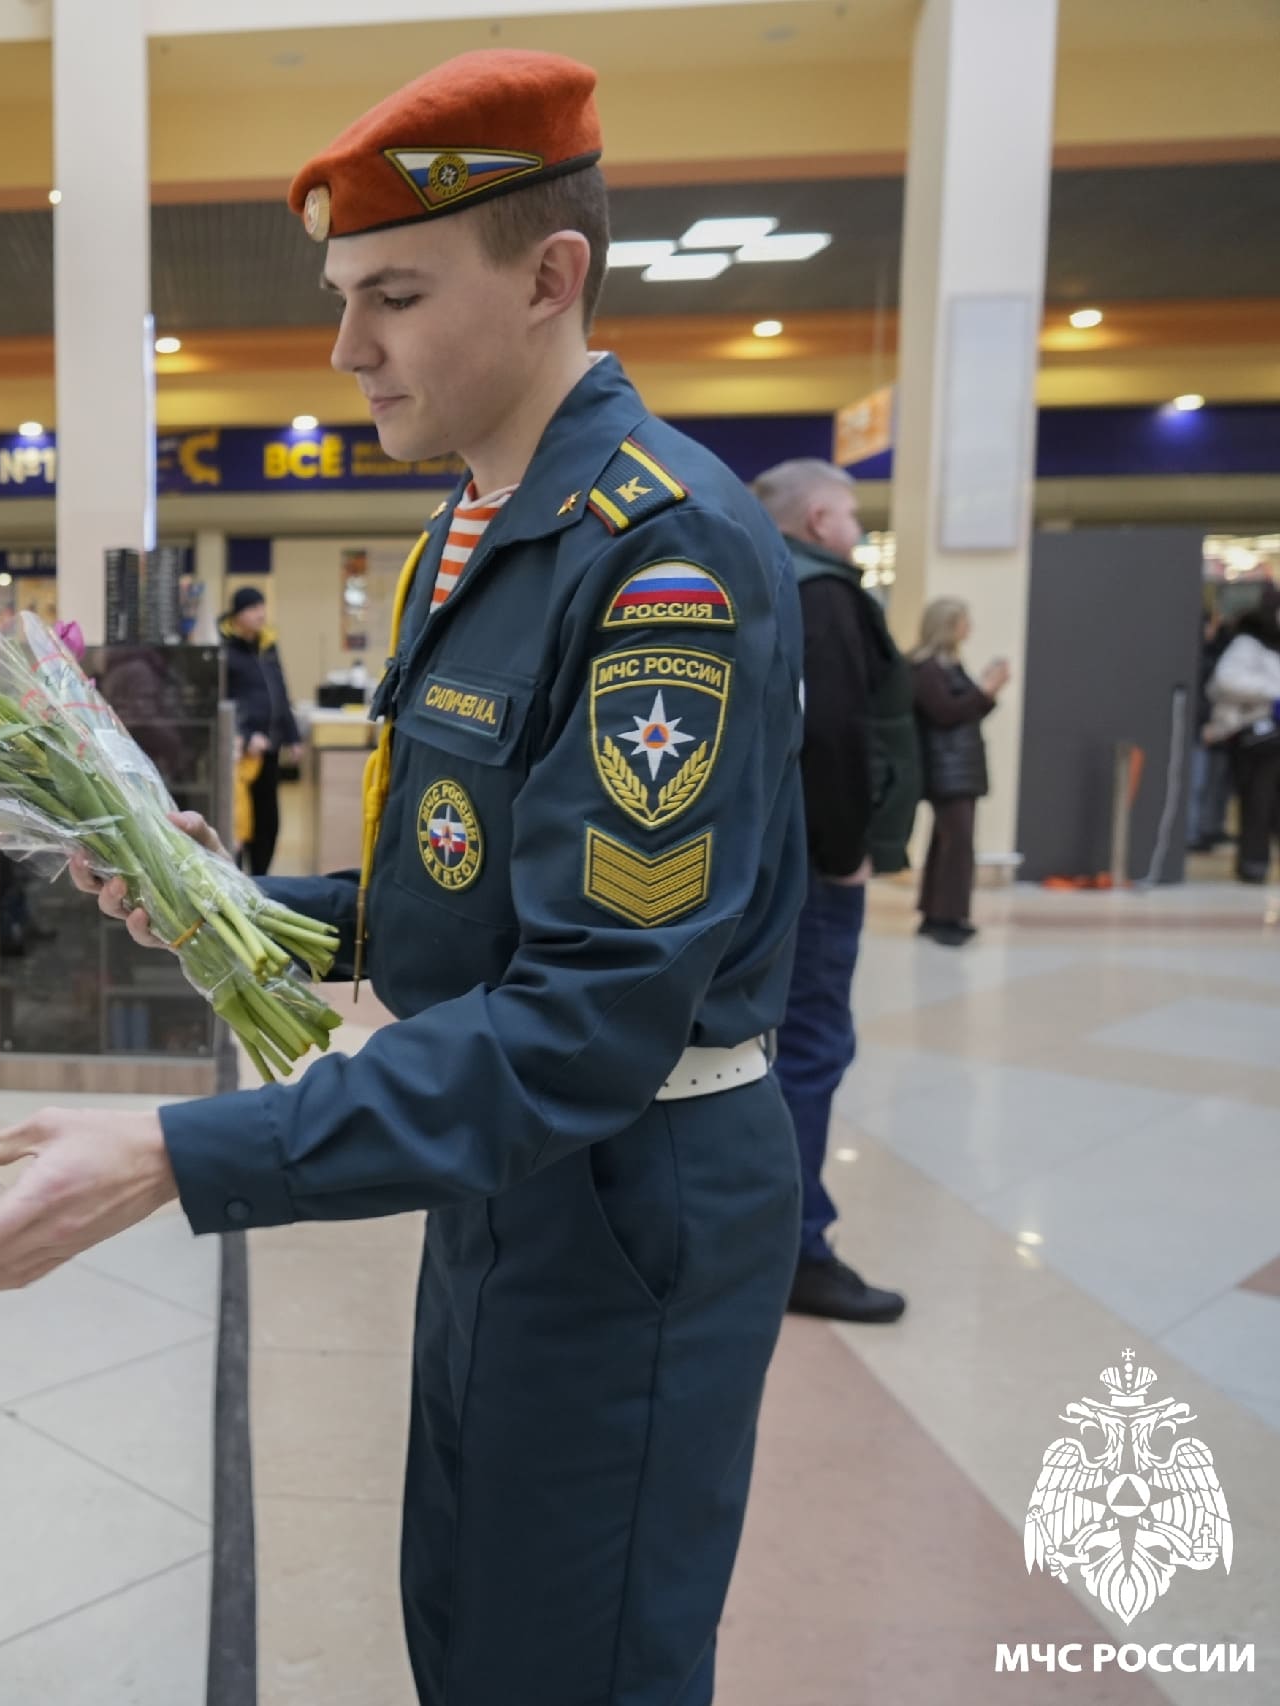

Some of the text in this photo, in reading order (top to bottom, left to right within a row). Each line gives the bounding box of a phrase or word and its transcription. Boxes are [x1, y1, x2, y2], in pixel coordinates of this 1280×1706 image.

[623, 602, 713, 620] РОССИЯ
[599, 656, 722, 687] МЧС РОССИИ
[421, 784, 478, 842] МЧС РОССИИ
